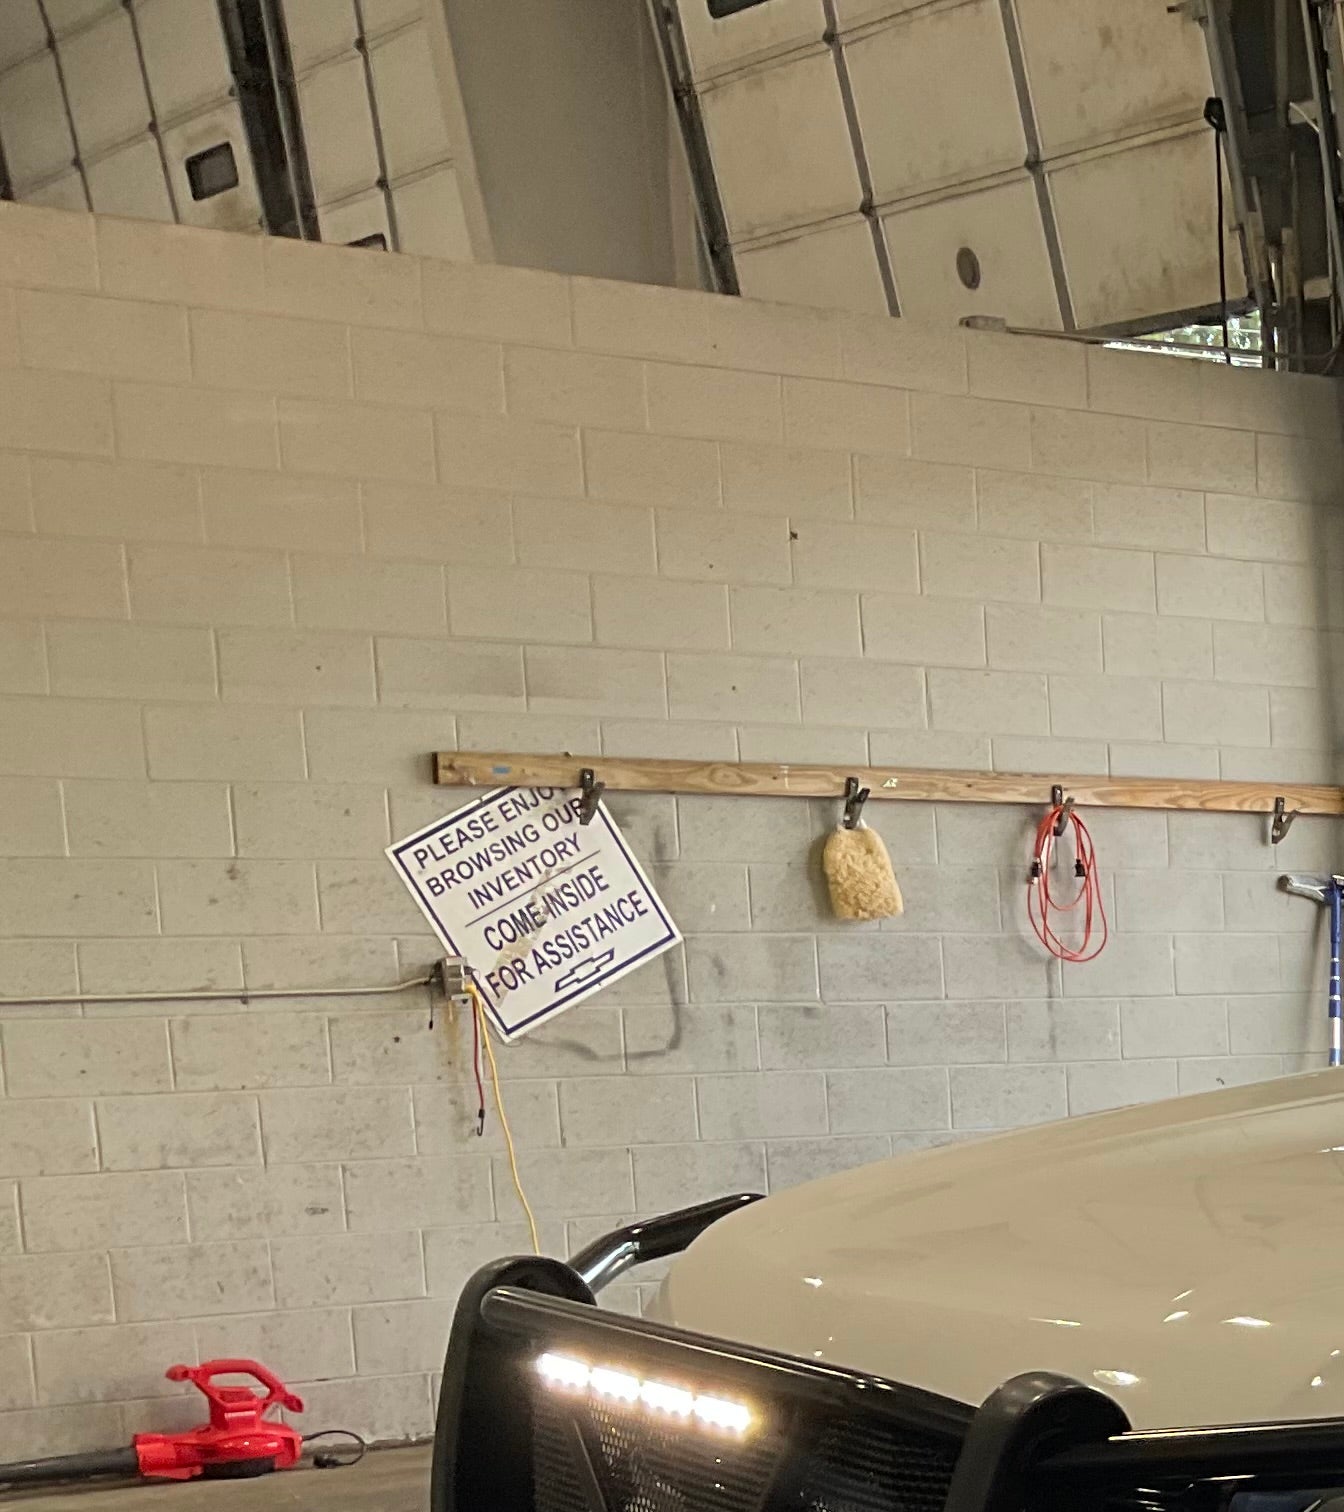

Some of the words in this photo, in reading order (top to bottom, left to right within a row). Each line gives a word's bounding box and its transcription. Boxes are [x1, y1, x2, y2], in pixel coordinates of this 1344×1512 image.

[412, 811, 499, 869] PLEASE
[498, 787, 566, 822] ENJO
[425, 823, 541, 897] BROWSING
[467, 833, 582, 909] INVENTORY
[483, 900, 546, 951] COME
[542, 865, 610, 919] INSIDE
[485, 959, 536, 999] FOR
[533, 890, 649, 974] ASSISTANCE
